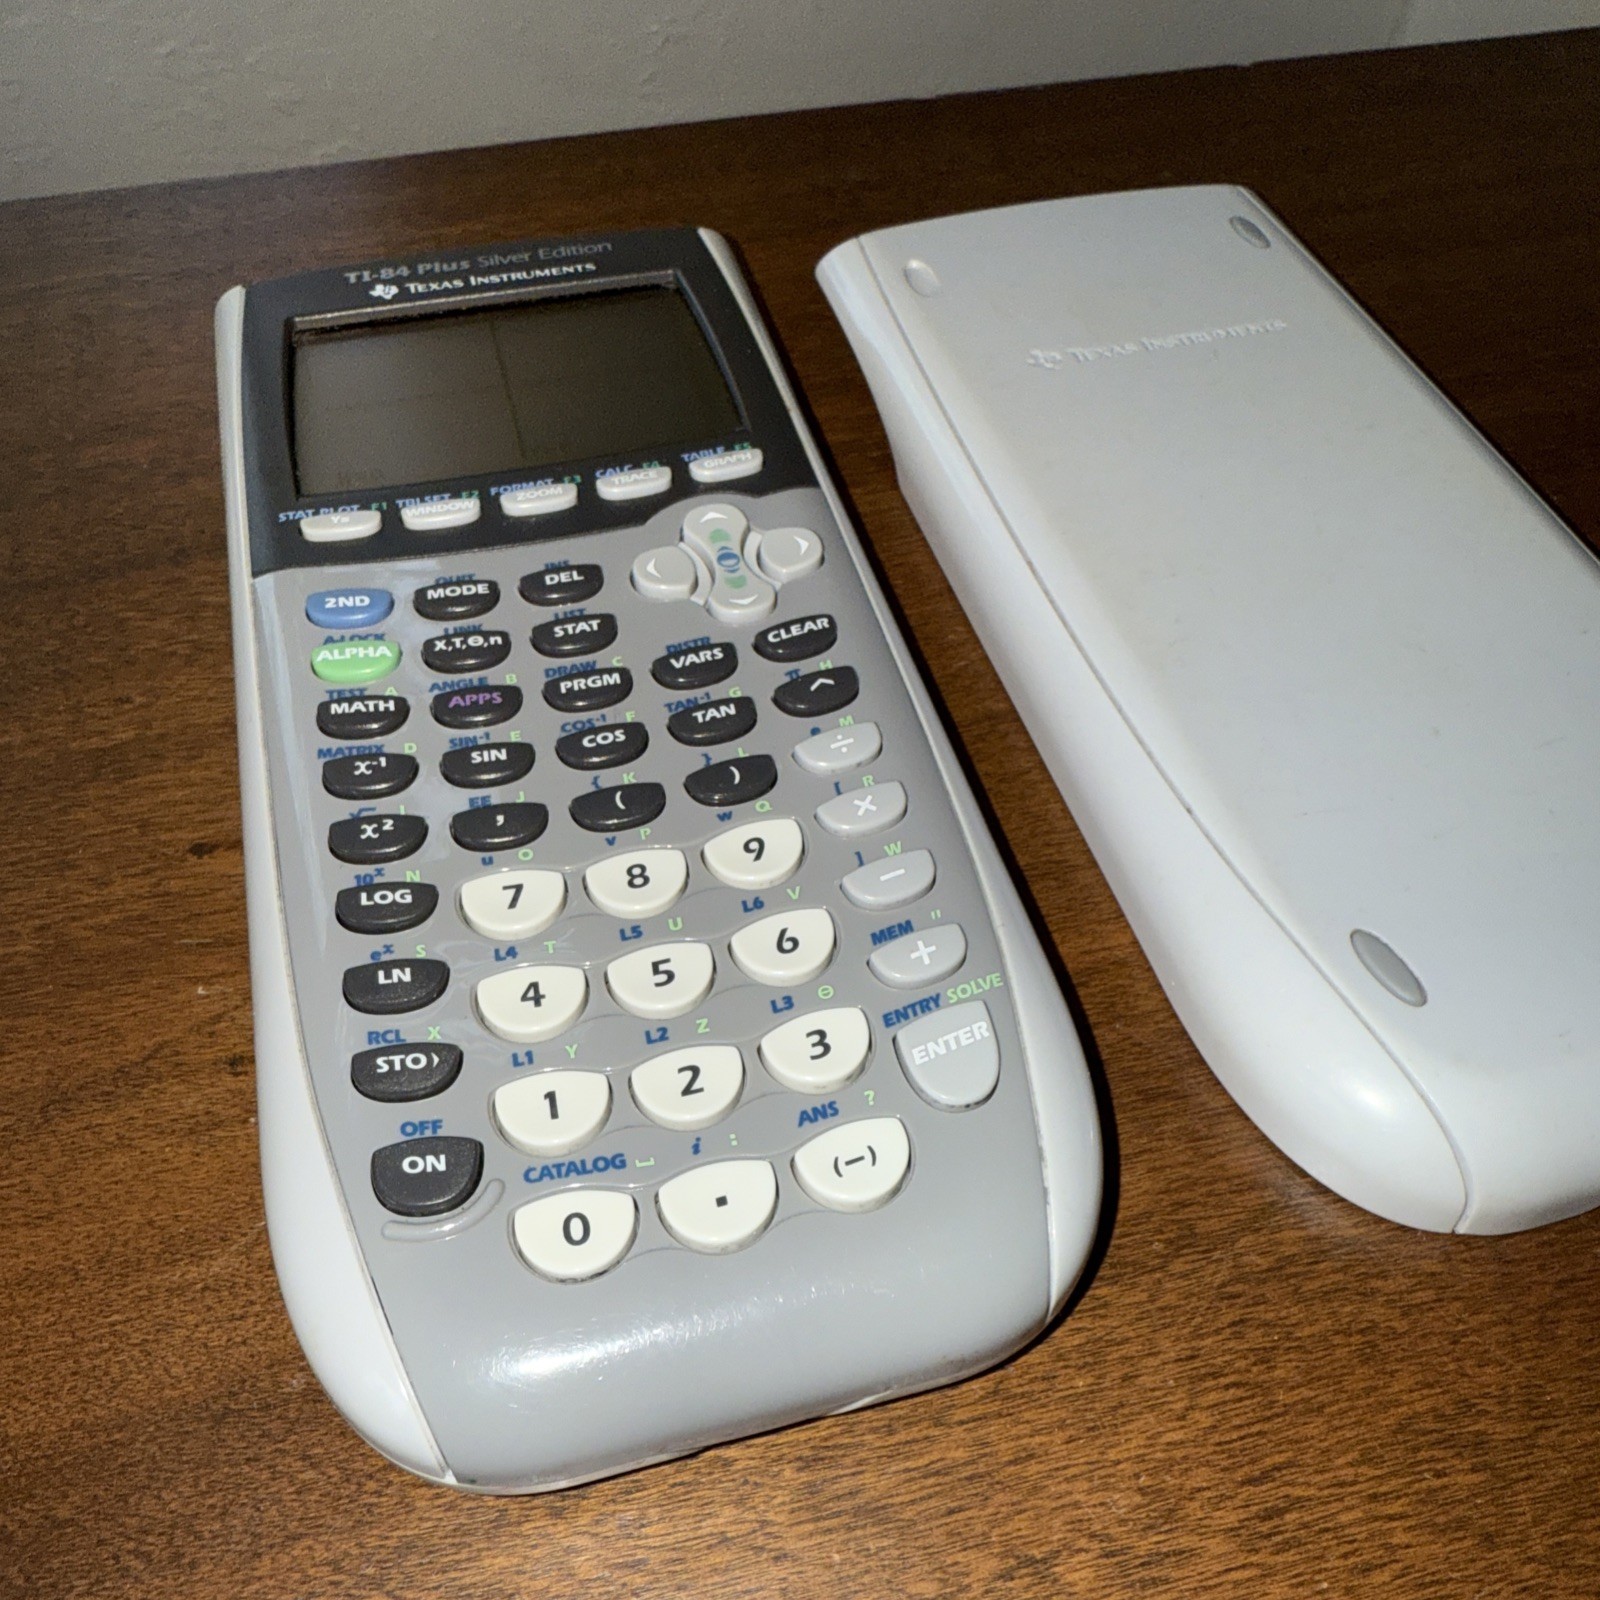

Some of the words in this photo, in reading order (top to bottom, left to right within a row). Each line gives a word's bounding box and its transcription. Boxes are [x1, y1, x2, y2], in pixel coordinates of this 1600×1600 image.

[417, 259, 471, 275] Plus
[477, 251, 531, 269] Silver
[539, 242, 613, 260] Edition
[405, 279, 464, 294] TEXAS
[470, 262, 596, 286] INSTRUMENTS
[516, 487, 563, 501] ZOOM
[406, 501, 475, 517] WINDOW
[544, 570, 585, 585] DEL
[427, 583, 490, 600] MODE
[325, 596, 370, 609] 2ND
[553, 619, 600, 638] STAT
[767, 618, 830, 643] CLEAR
[316, 645, 392, 661] ALPHA
[669, 647, 724, 669] VARS
[544, 660, 597, 679] DRAW
[612, 656, 623, 667] C
[819, 659, 832, 671] H
[429, 676, 489, 693] ANGLE
[505, 674, 518, 685] B
[560, 672, 621, 694] PRGM
[384, 686, 399, 696] A
[729, 687, 742, 698] G
[330, 699, 396, 715] MATH
[449, 691, 503, 709] APPS
[625, 711, 637, 722] F
[692, 703, 736, 724] TAN
[838, 715, 855, 727] M
[510, 731, 522, 742] E
[582, 729, 626, 748] COS
[403, 743, 417, 754] D
[471, 749, 508, 764] SIN
[738, 747, 749, 758] L
[622, 772, 637, 784] K
[862, 775, 875, 787] R
[468, 795, 492, 808] EE
[515, 791, 525, 802] J
[754, 800, 773, 812] Q
[639, 828, 651, 840] P
[517, 848, 534, 861] O
[742, 837, 765, 862] 9
[884, 841, 902, 857] W
[406, 869, 421, 883] N
[626, 863, 650, 889] 8
[360, 889, 413, 906] LOG
[501, 883, 524, 910] 7
[786, 886, 801, 900] V
[741, 897, 765, 913] L6
[667, 917, 684, 931] U
[619, 925, 644, 942] L5
[776, 927, 800, 954] 6
[870, 920, 914, 946] MEM
[416, 944, 426, 958] S
[494, 946, 518, 961] L4
[543, 940, 557, 954] T
[378, 967, 412, 985] LN
[651, 958, 676, 988] 5
[520, 981, 546, 1008] 4
[882, 992, 942, 1029] ENTRY
[946, 972, 1004, 1004] SOLVE
[770, 995, 795, 1014] L3
[427, 1026, 442, 1041] X
[695, 1018, 710, 1034] Z
[367, 1029, 406, 1045] RCL
[644, 1027, 670, 1045] L2
[911, 1020, 990, 1066] ENTER
[564, 1044, 578, 1059] Y
[805, 1028, 832, 1061] 3
[512, 1050, 534, 1068] L1
[677, 1064, 705, 1097] 2
[543, 1090, 560, 1120] 1
[797, 1101, 840, 1128] ANS
[400, 1119, 444, 1137] OFF
[401, 1154, 447, 1175] ON
[522, 1153, 628, 1184] CATALOG
[562, 1212, 591, 1246] 0
